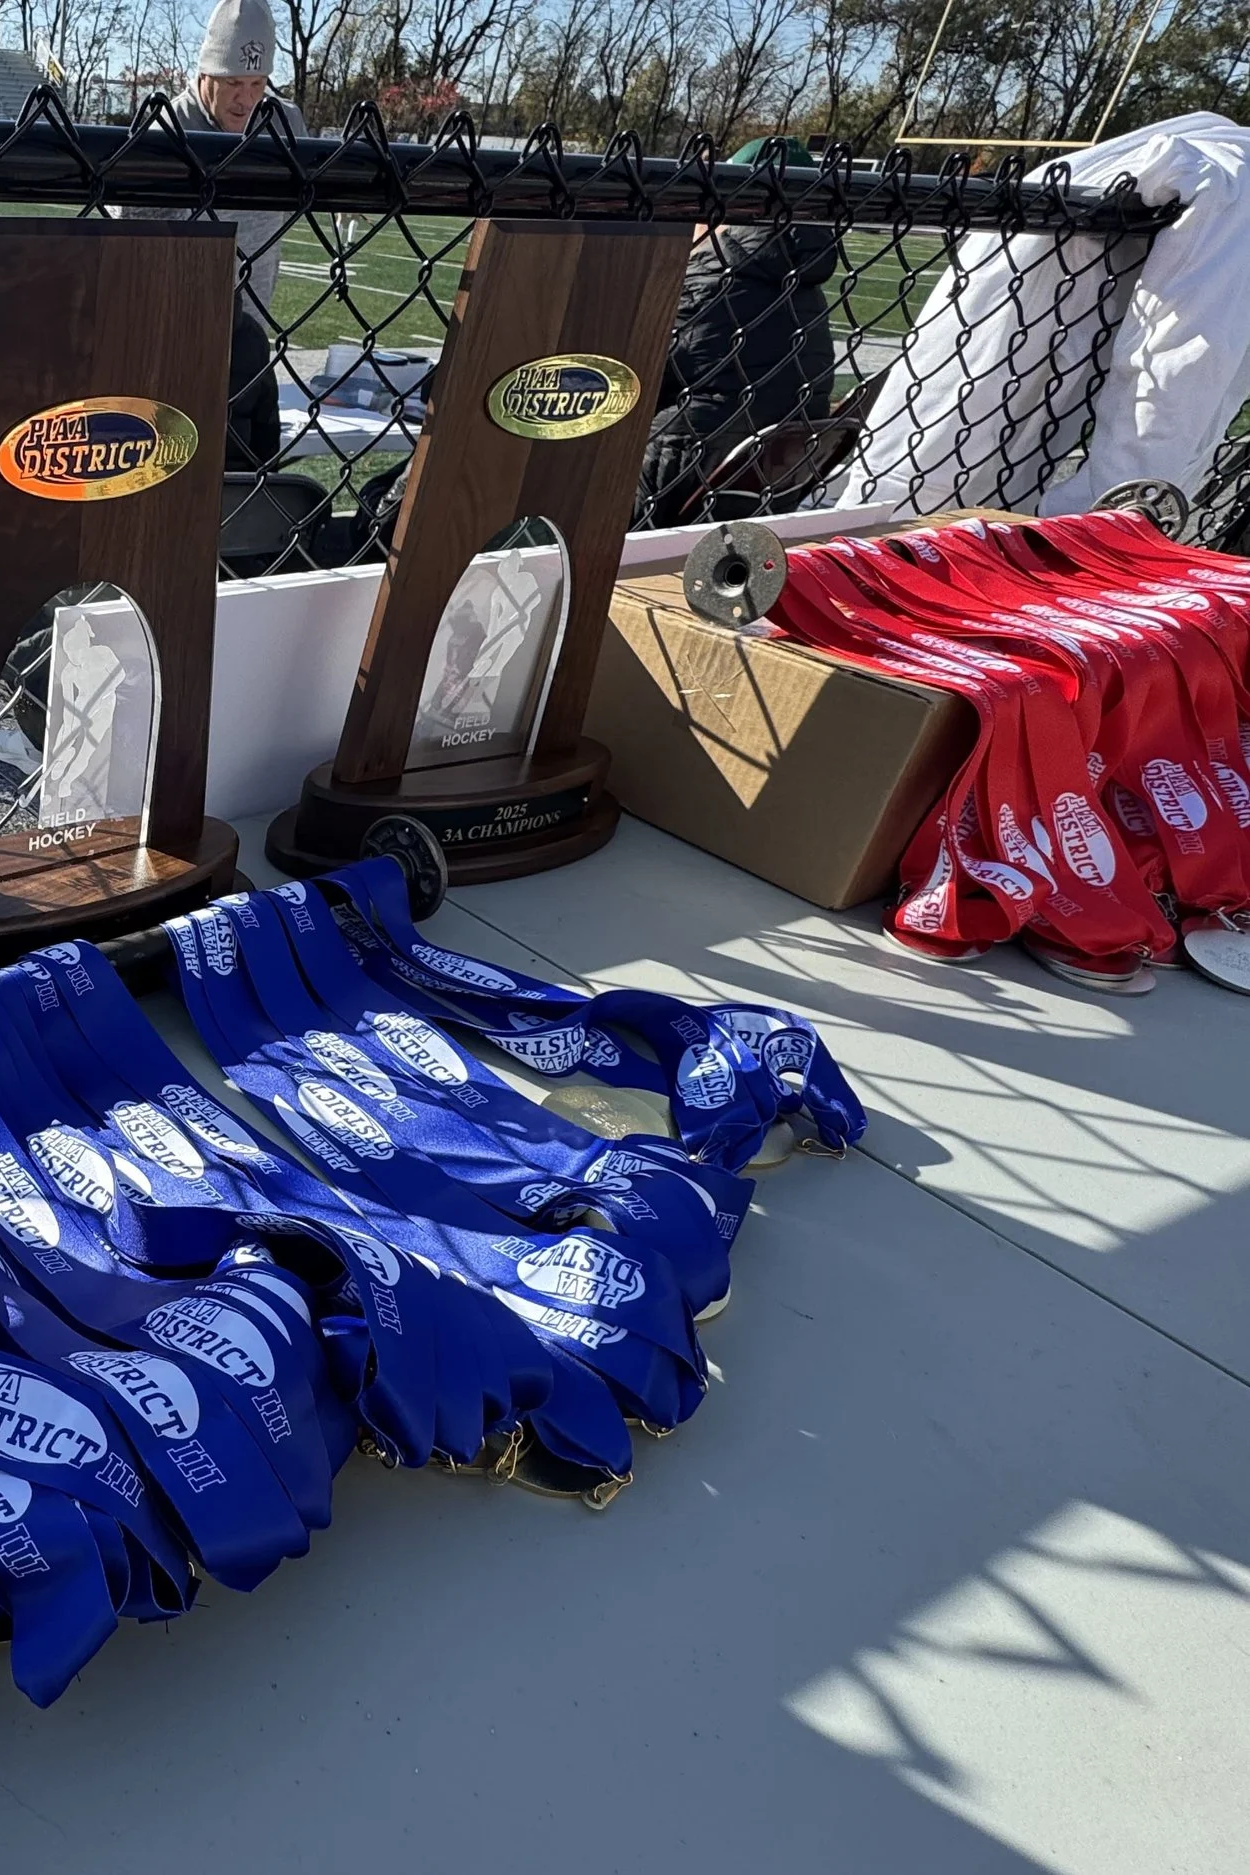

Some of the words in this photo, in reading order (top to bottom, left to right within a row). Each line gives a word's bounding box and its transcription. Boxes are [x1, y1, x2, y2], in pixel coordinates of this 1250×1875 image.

[515, 368, 561, 390] PIAA
[503, 391, 605, 418] DISTRICT
[27, 413, 89, 446] PIAA
[20, 439, 152, 480] DISTRICT
[156, 434, 193, 466] III
[442, 728, 496, 748] HOCKEY
[453, 715, 491, 730] FIELD
[1140, 764, 1196, 833] DISTRICT
[1165, 764, 1196, 797] PIAA
[41, 808, 86, 828] FIELD
[442, 828, 464, 843] 3A
[467, 810, 562, 840] CHAMPIONS
[494, 803, 529, 820] 2025
[1070, 795, 1103, 838] PIAA
[29, 823, 97, 851] HOCKEY
[1052, 801, 1106, 887] DISTRICT
[176, 926, 200, 972] PIAA
[200, 919, 219, 967] PIAA
[420, 946, 467, 969] PIAA
[414, 951, 514, 992] DISTRICT
[389, 1011, 435, 1044] PIAA
[301, 1036, 392, 1101] DISTRICT
[371, 1019, 462, 1087] DISTRICT
[128, 1101, 169, 1137] PIAA
[158, 1089, 259, 1156] DISTRICT
[178, 1085, 223, 1121] PIAA
[305, 1083, 400, 1152] DISTRICT
[40, 1128, 85, 1164] PIAA
[108, 1106, 199, 1182] DISTRICT
[304, 1130, 347, 1170] PIAA
[330, 1121, 377, 1158] PIAA
[370, 1282, 403, 1335] III
[558, 1271, 628, 1309] PIAA
[164, 1297, 223, 1325] PIAA
[540, 1307, 609, 1351] PIAA
[140, 1311, 267, 1386] DISTRICT
[251, 1387, 294, 1444] III
[70, 1354, 188, 1437] DISTRICT
[166, 1439, 227, 1493] III
[95, 1452, 147, 1508] III
